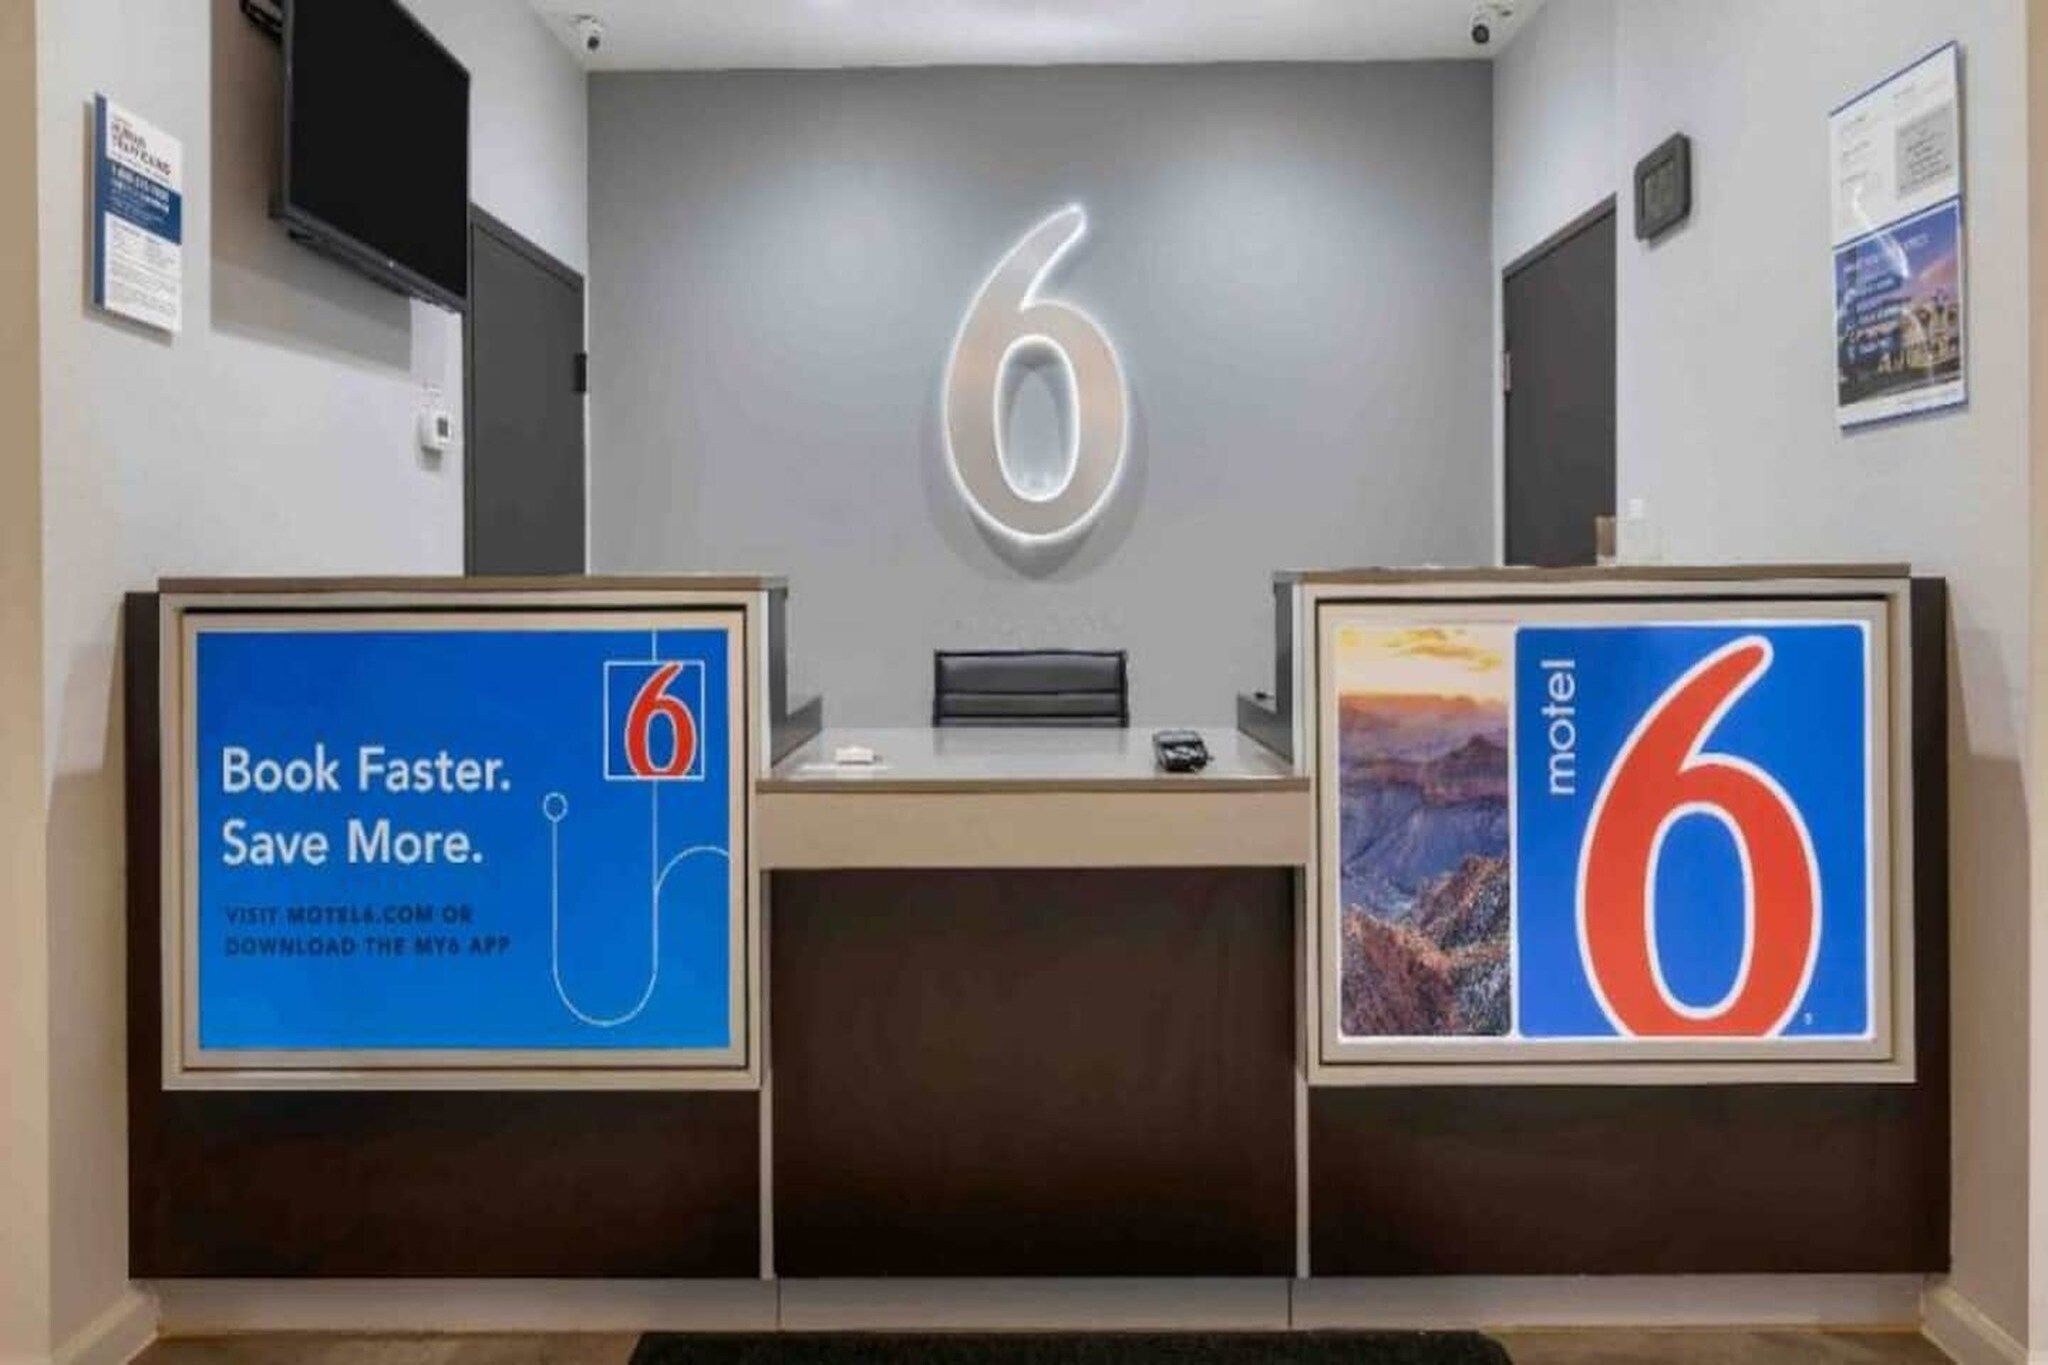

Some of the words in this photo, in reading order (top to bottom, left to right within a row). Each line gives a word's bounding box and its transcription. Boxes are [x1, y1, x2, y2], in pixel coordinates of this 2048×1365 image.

[942, 203, 1129, 544] 6
[624, 661, 698, 780] 6
[222, 742, 341, 793] Book
[358, 746, 511, 793] Faster.
[222, 818, 330, 866] Save
[347, 818, 483, 865] More.
[1540, 659, 1576, 796] motel
[1576, 635, 1822, 1038] 6
[225, 905, 277, 925] VISIT
[287, 904, 433, 925] MOTEL6.COM
[442, 904, 473, 924] OR
[225, 936, 357, 957] DOWNLOAD
[364, 936, 406, 956] THE
[414, 936, 460, 956] MY6
[469, 935, 510, 955] APP
